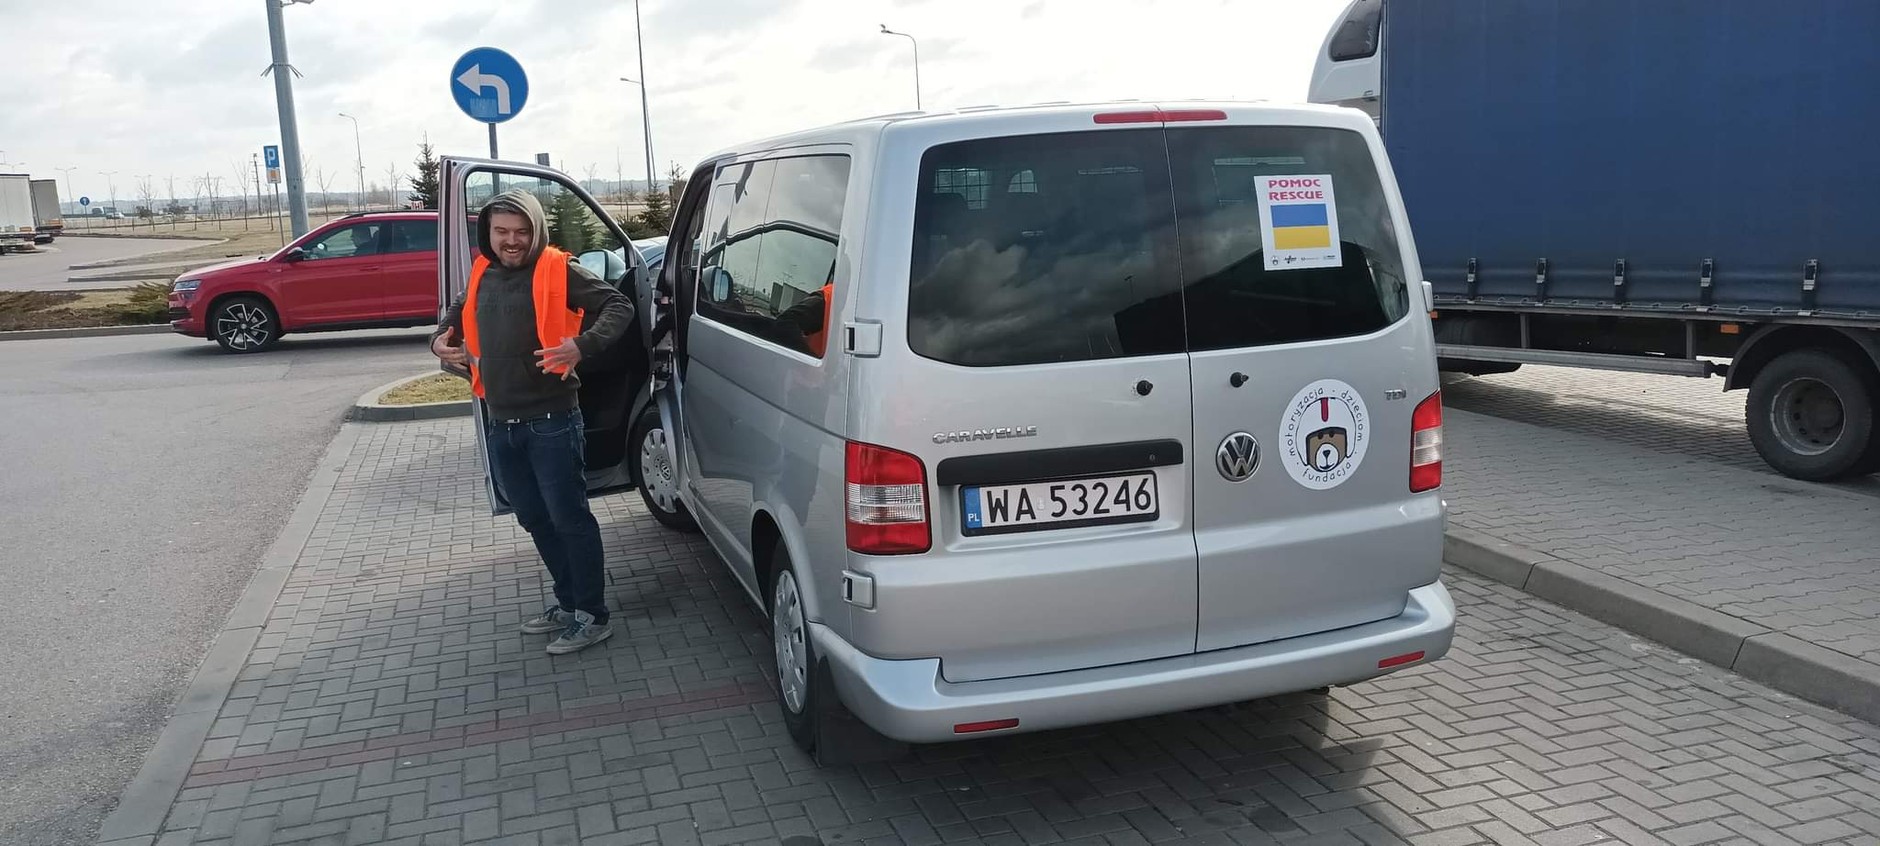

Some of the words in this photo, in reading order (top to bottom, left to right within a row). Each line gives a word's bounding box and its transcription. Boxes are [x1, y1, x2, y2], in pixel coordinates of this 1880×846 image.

[267, 148, 276, 166] P
[1268, 179, 1321, 188] POMOC
[1269, 191, 1324, 201] RESCUE
[1384, 389, 1406, 400] TDI
[1285, 387, 1324, 457] motoryzacja
[1341, 389, 1363, 442] dzieciom
[932, 425, 1038, 444] CARAVELLE
[1216, 431, 1262, 483] VW
[1302, 462, 1352, 483] fundacja
[986, 487, 1037, 523] WA
[1049, 477, 1152, 518] 53246
[967, 513, 980, 522] PL
